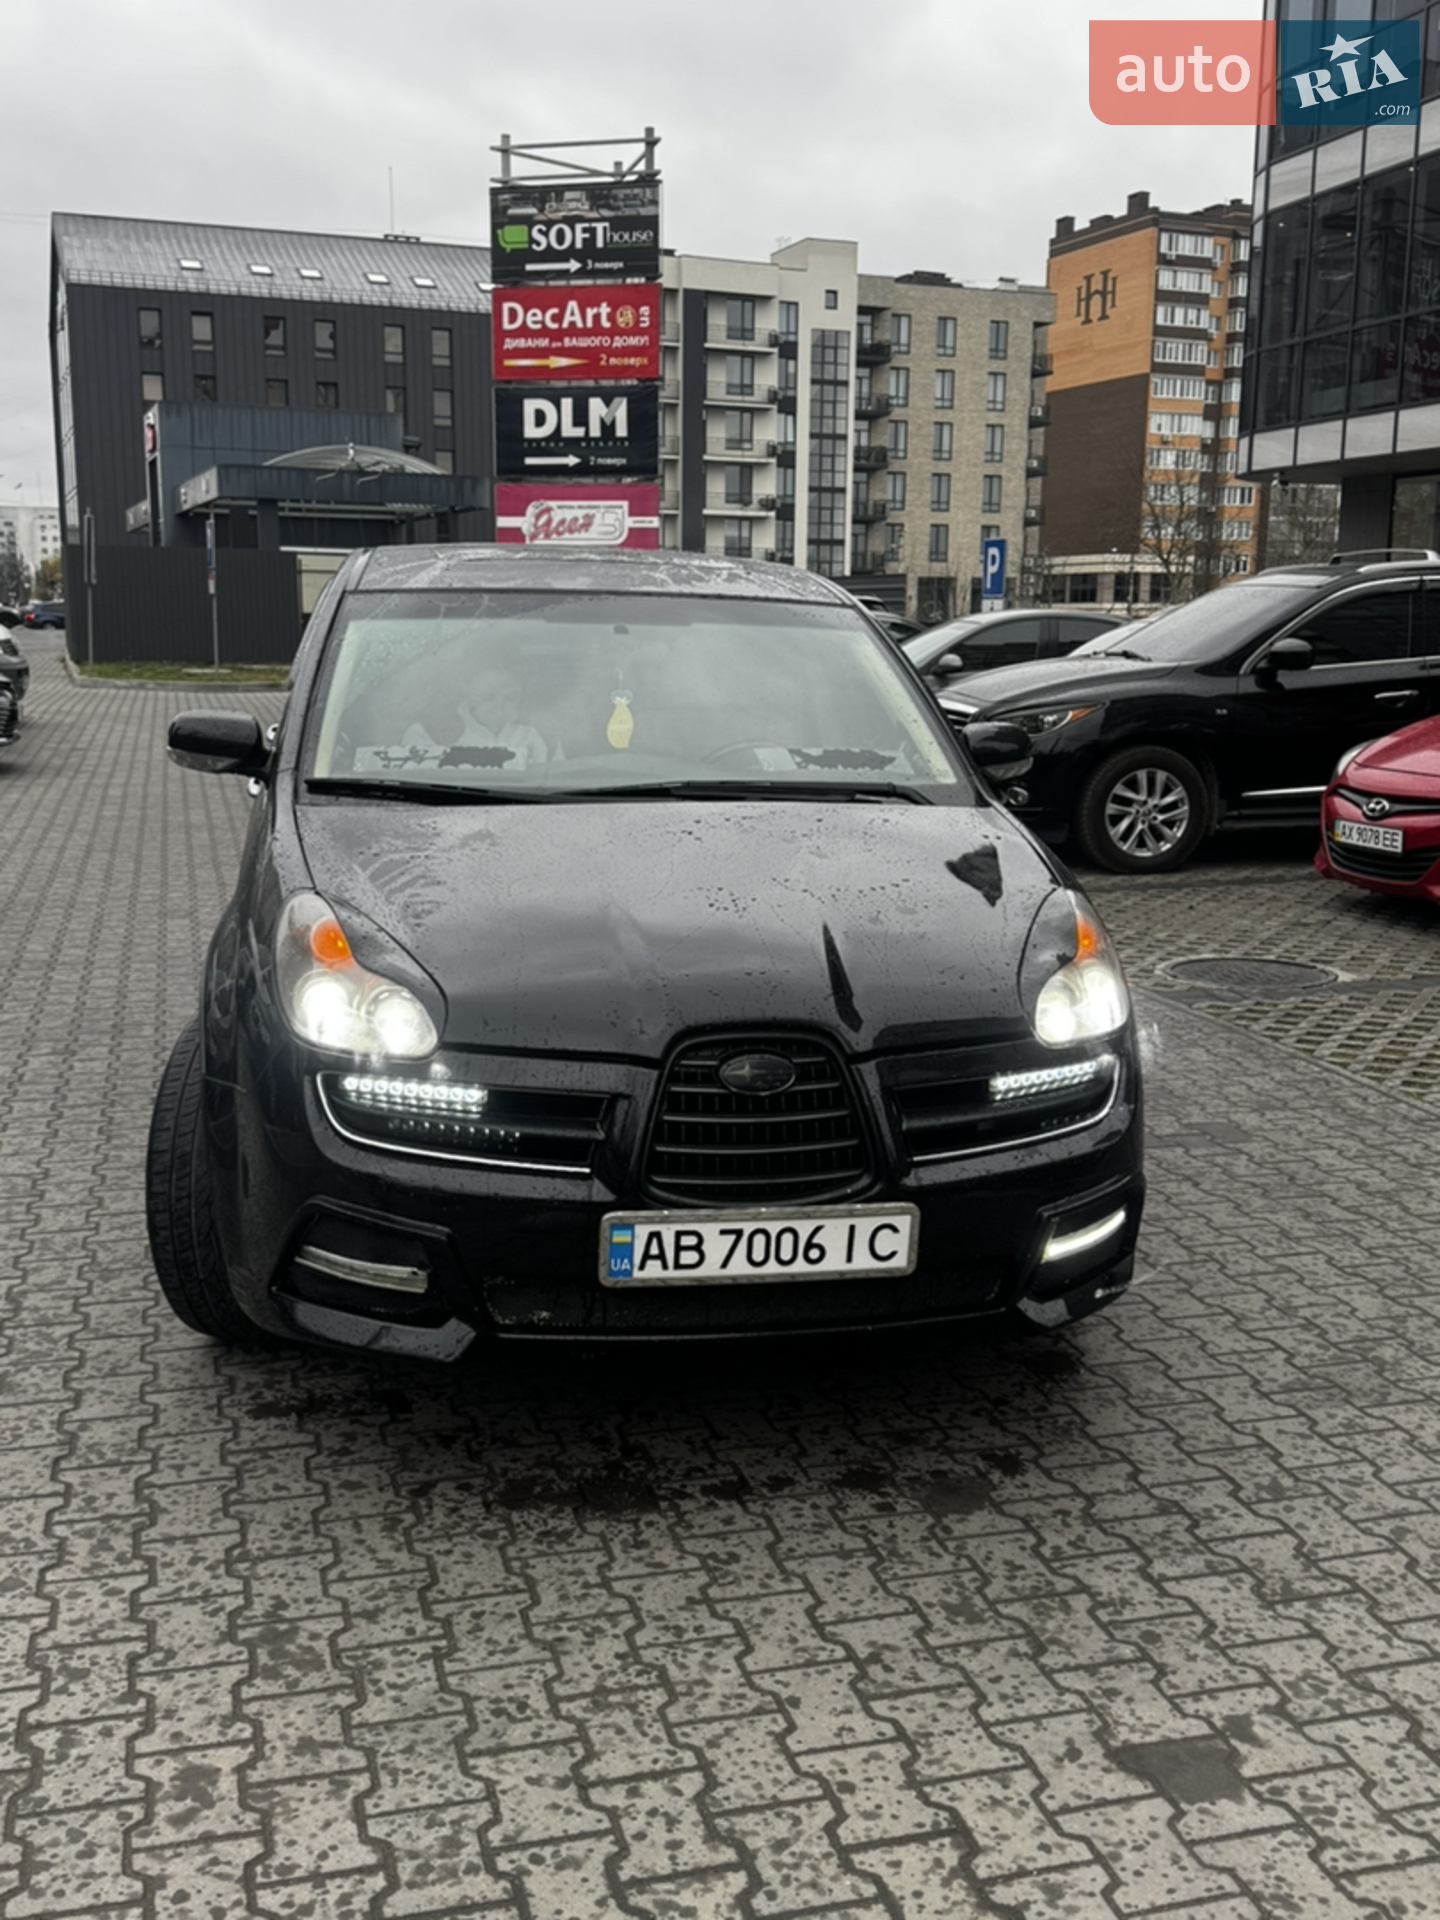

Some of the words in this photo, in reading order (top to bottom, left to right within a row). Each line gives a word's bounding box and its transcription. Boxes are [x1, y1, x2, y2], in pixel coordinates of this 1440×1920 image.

[502, 299, 611, 331] DecArt
[503, 338, 550, 350] ДИВАНИ
[563, 336, 611, 348] ВАШОГО
[599, 353, 607, 366] 2
[609, 356, 649, 368] поверх
[523, 397, 628, 438] DLM
[589, 456, 595, 466] 2
[597, 458, 627, 467] поверх
[986, 547, 1001, 589] P
[1356, 826, 1380, 846] 9078
[1382, 831, 1400, 849] EE
[638, 1230, 706, 1271] AB
[718, 1224, 827, 1269] 7006
[846, 1223, 900, 1264] IC
[611, 1258, 631, 1271] UA
